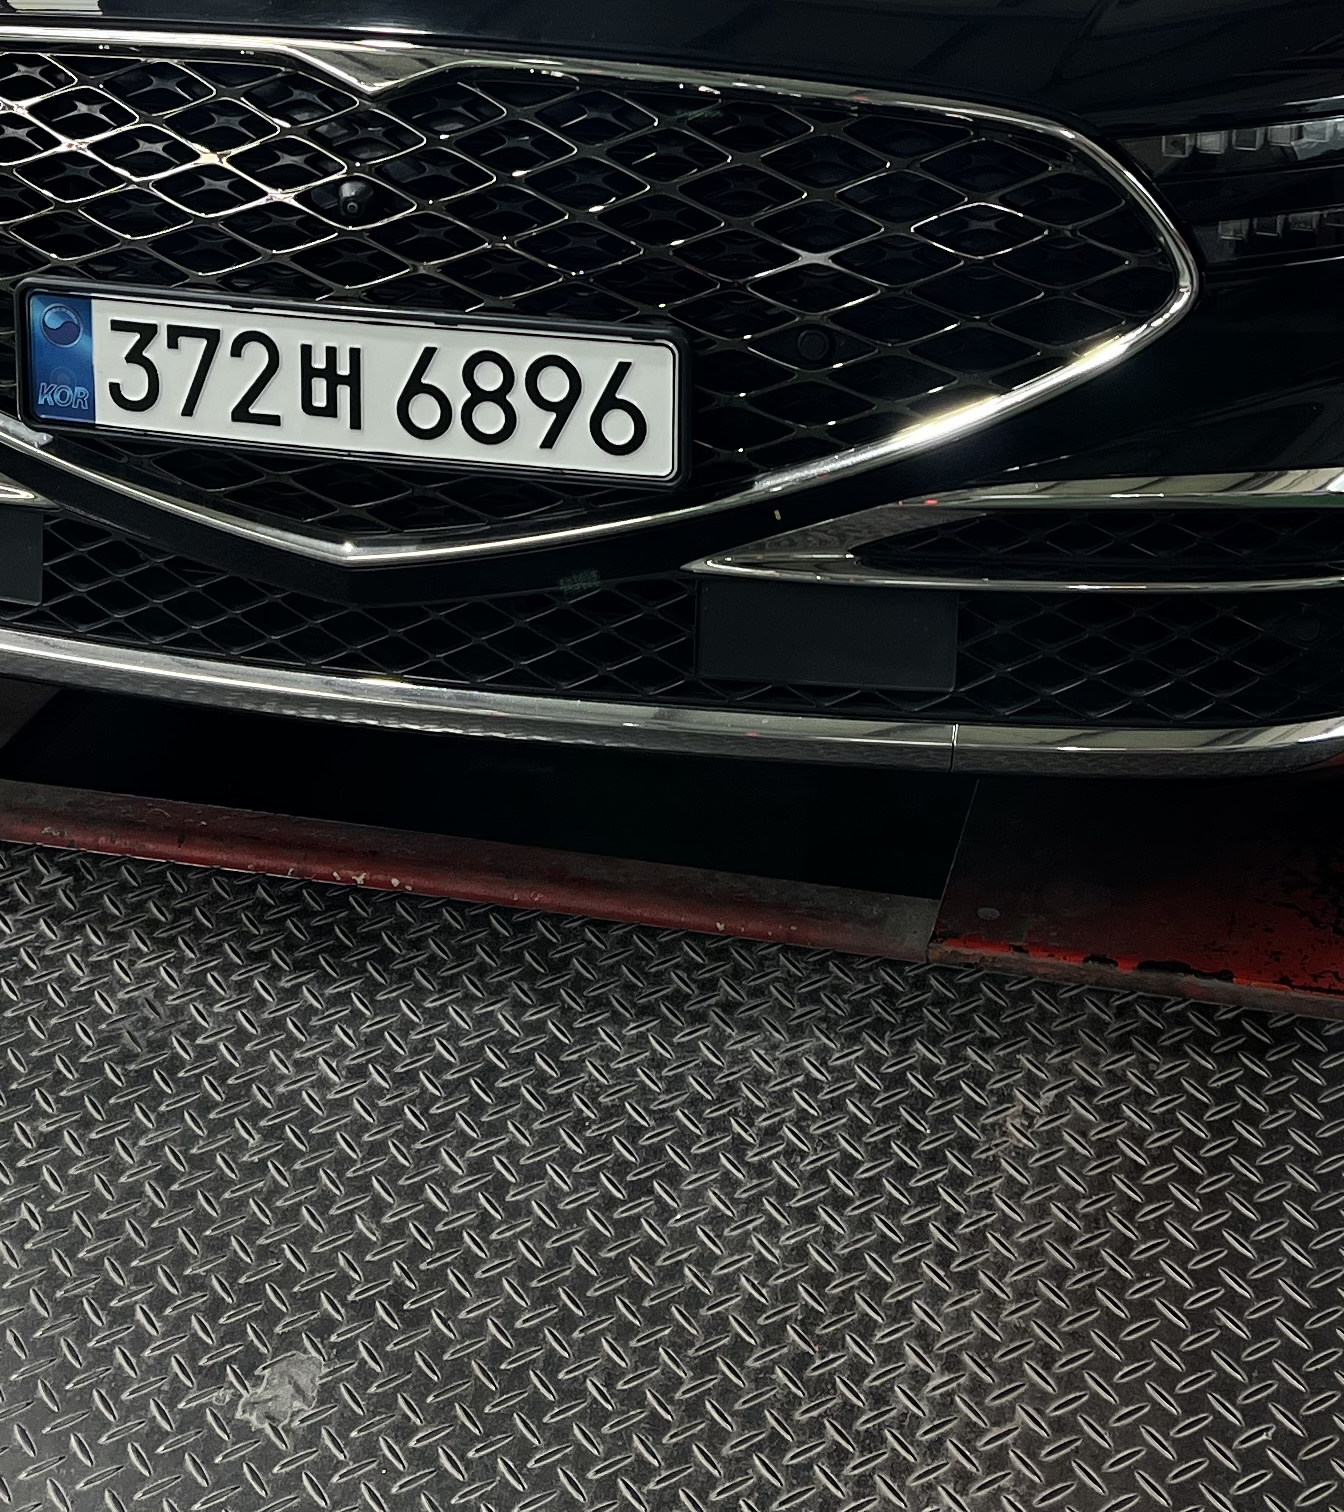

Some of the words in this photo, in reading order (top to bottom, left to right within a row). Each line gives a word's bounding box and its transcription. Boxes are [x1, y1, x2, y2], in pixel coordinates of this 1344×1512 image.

[38, 382, 90, 410] KOR
[108, 319, 362, 430] 372버
[396, 346, 647, 456] 6896
